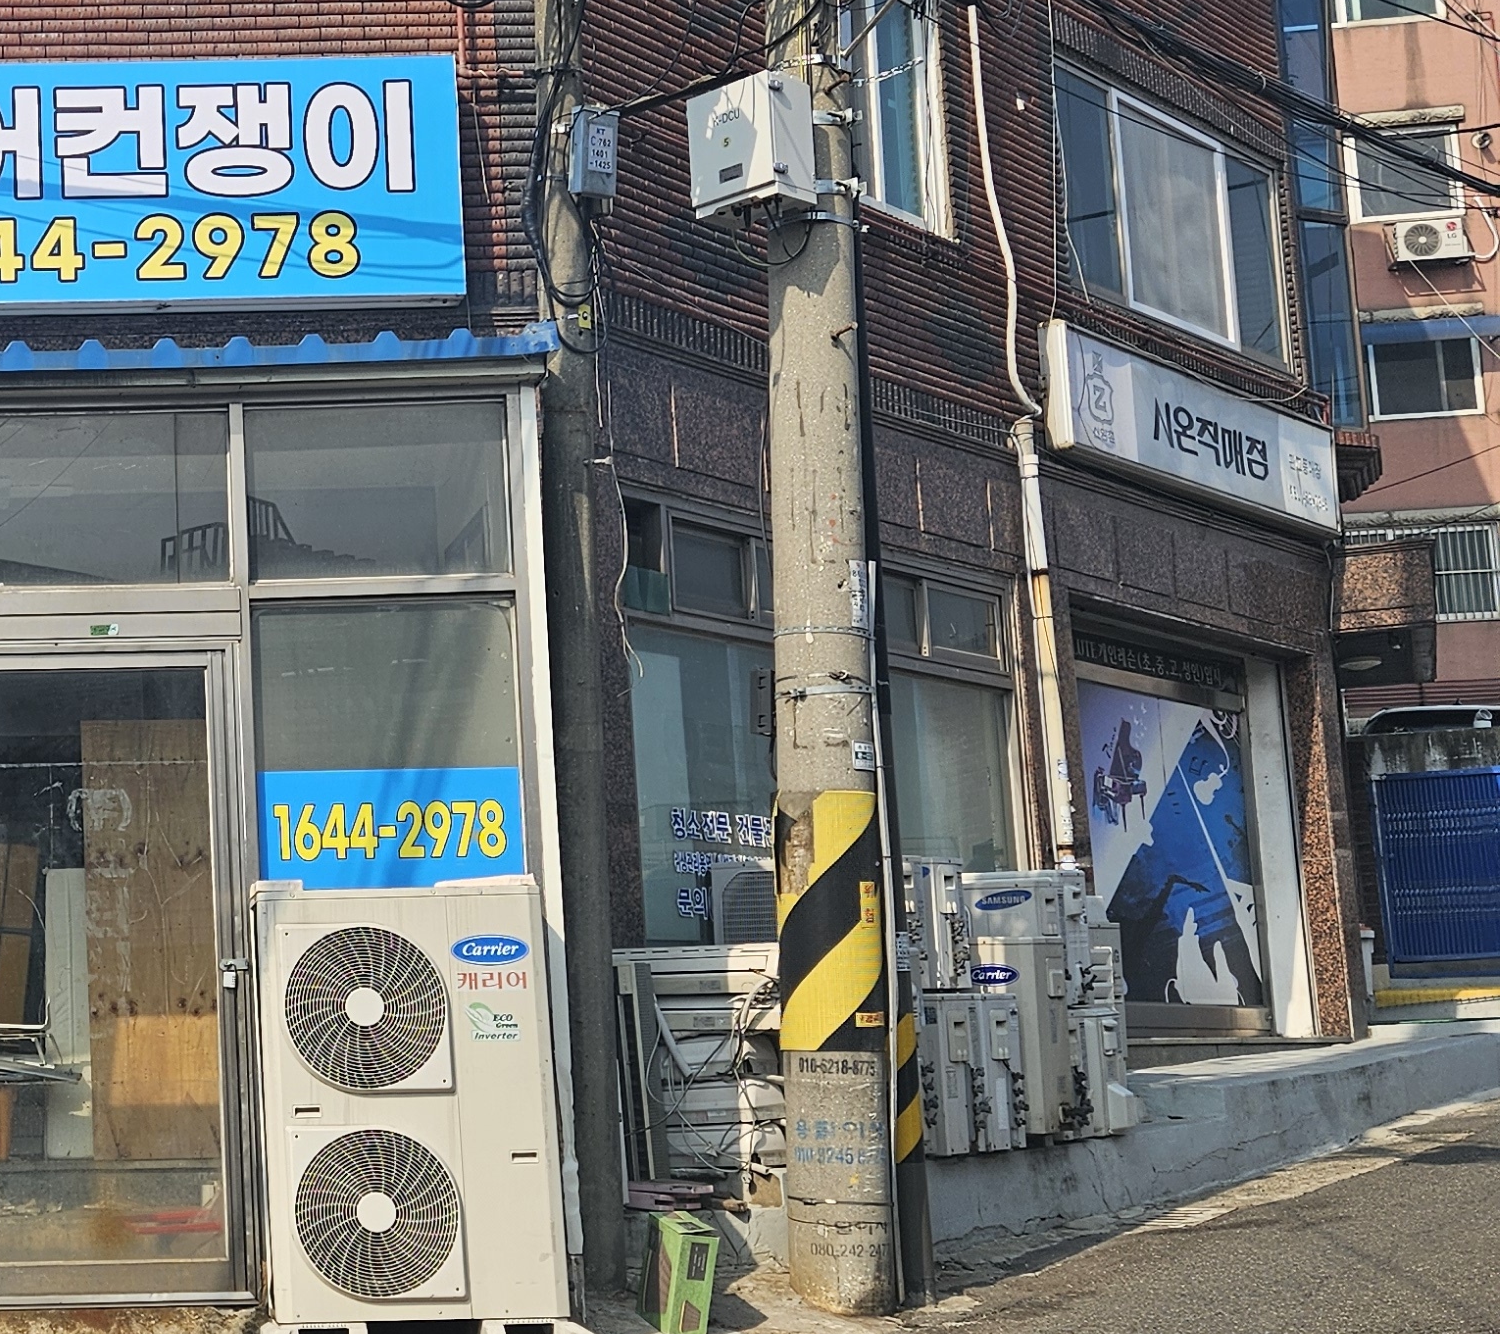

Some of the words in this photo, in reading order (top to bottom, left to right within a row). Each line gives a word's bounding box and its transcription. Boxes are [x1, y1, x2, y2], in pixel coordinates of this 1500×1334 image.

[272, 799, 509, 862] 1644-2978
[670, 806, 733, 845] 청소전문
[980, 894, 1027, 905] SAMSUNG
[461, 941, 520, 957] Carrier
[456, 971, 529, 991] 캐리어
[971, 968, 1013, 981] Carrier
[492, 1013, 514, 1023] ECO
[474, 1031, 519, 1041] Inverter
